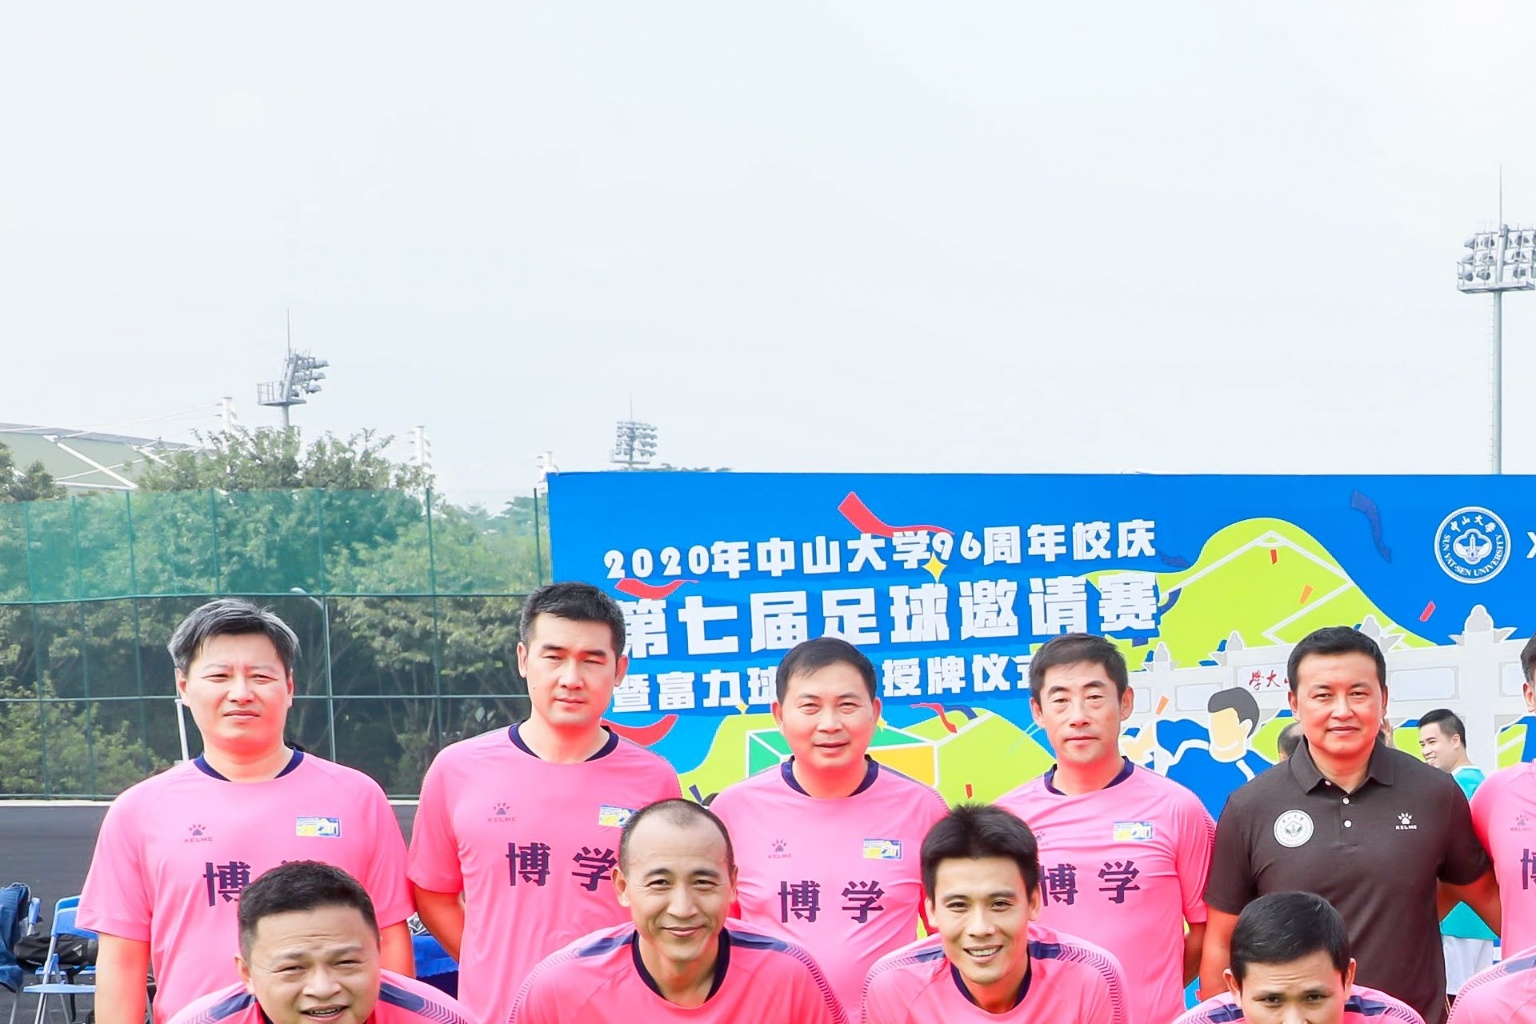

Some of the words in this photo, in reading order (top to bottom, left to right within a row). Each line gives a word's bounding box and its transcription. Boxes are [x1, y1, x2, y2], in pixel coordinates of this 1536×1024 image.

[604, 519, 1155, 579] 2020年中山大学96周年校庆
[1442, 534, 1451, 551] SUN
[615, 573, 1157, 658] 第七届足球邀请赛
[505, 842, 617, 892] 博学
[1038, 860, 1140, 906] 博学
[778, 880, 884, 923] 博学
